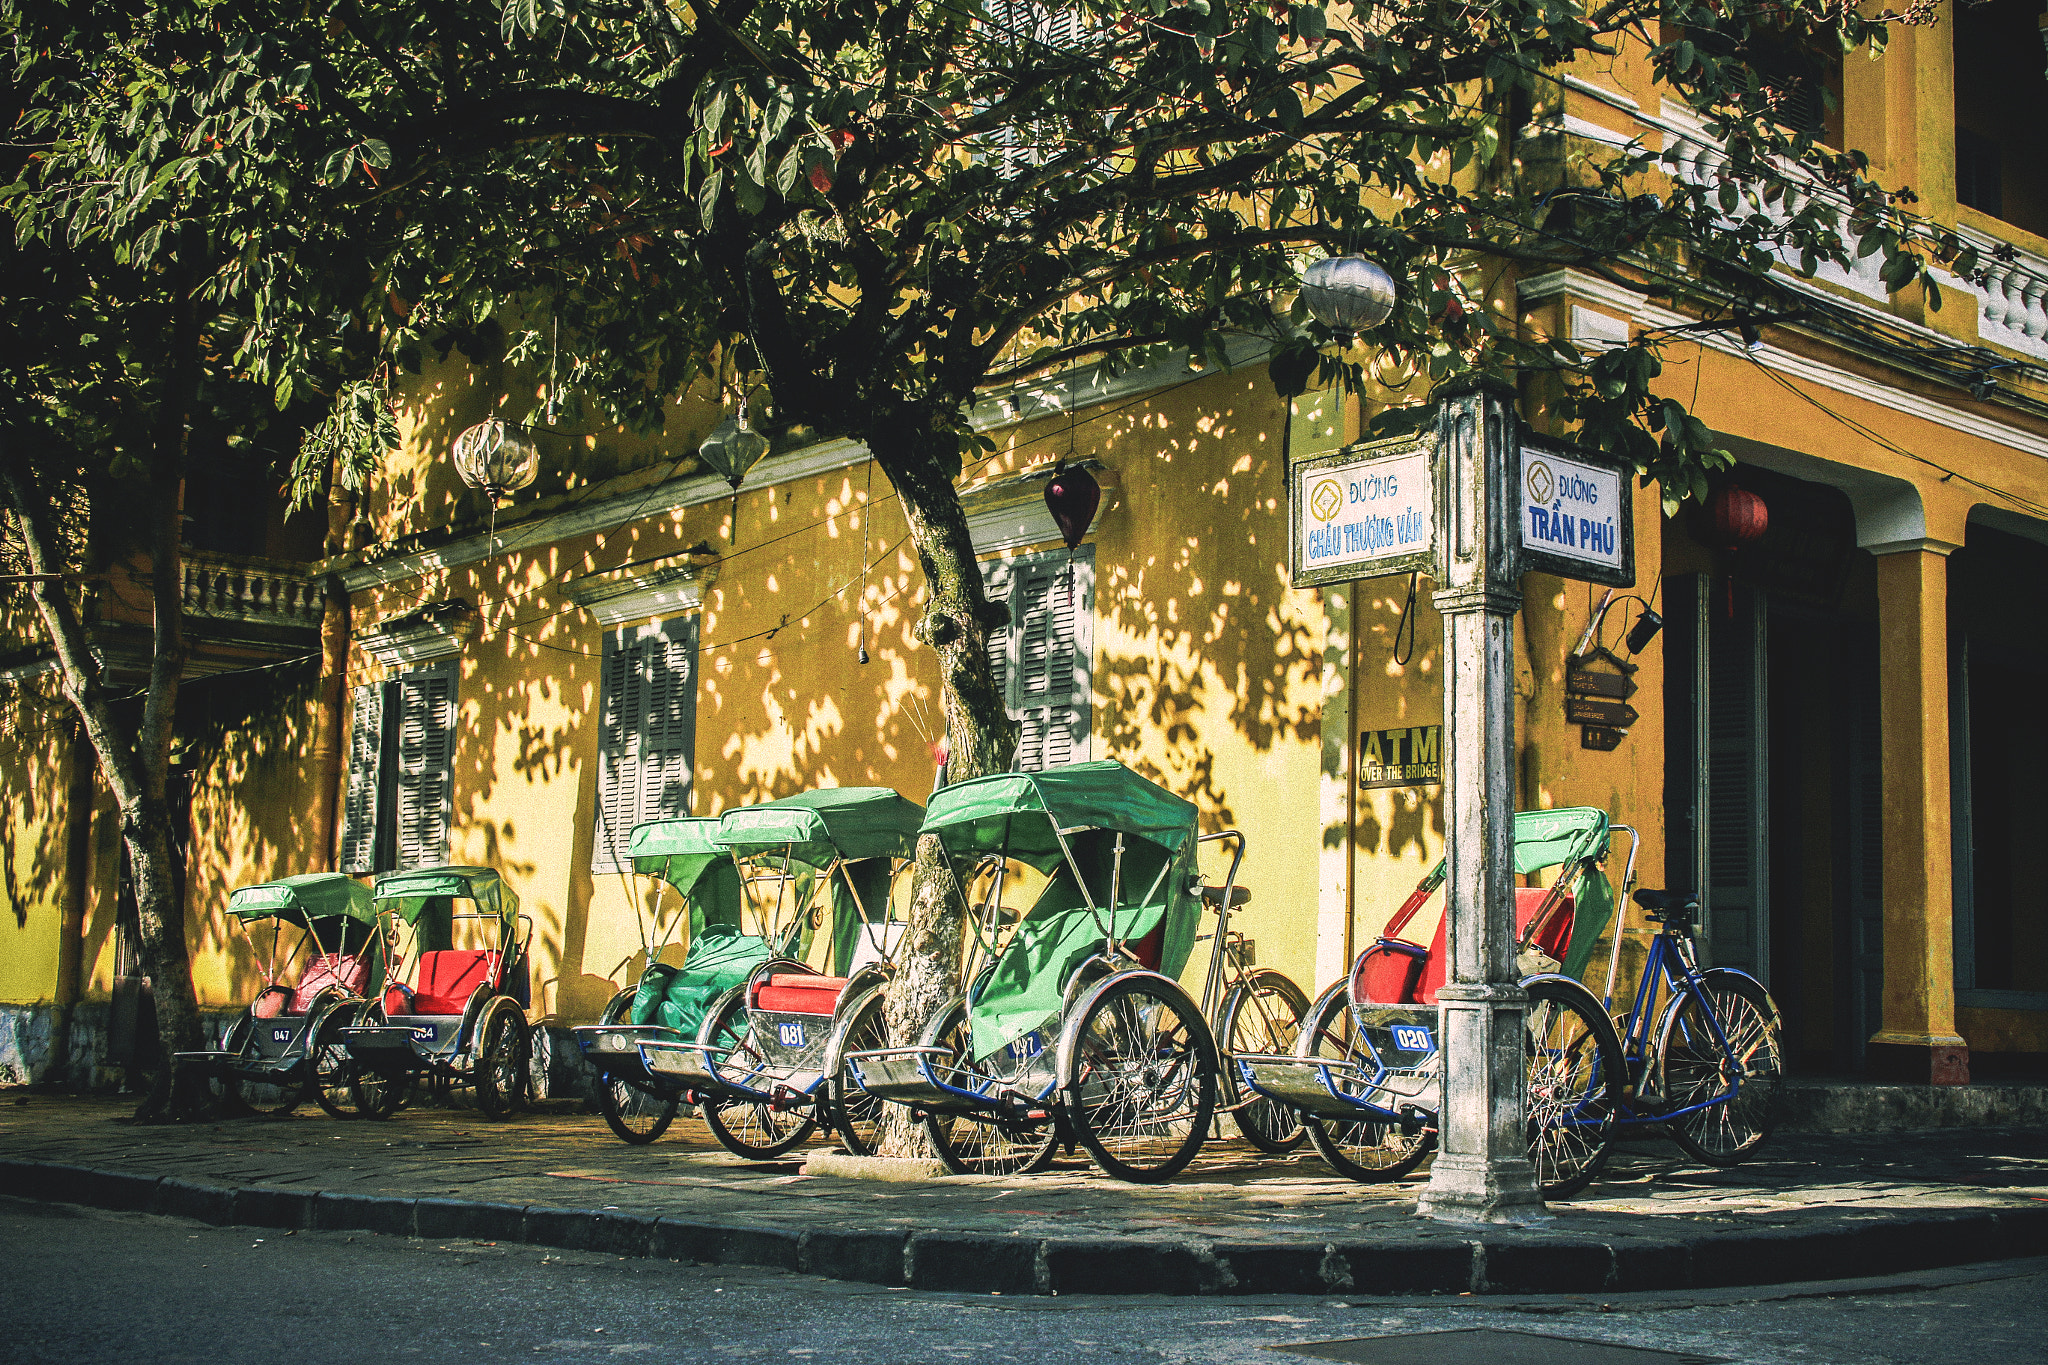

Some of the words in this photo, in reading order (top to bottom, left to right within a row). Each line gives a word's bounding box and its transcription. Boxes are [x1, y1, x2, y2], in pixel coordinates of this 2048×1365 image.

[1349, 473, 1398, 504] ĐƯỜNG
[1308, 521, 1342, 560] CHÂU
[1343, 513, 1394, 555] THƯỢNG
[1396, 505, 1423, 545] VĂN
[1528, 498, 1575, 548] TRẦN
[1580, 516, 1615, 556] PHÚ
[1361, 725, 1438, 767] ATM
[1360, 765, 1383, 782] OVER
[1386, 764, 1403, 780] THE
[1405, 762, 1438, 779] BRIDGE
[274, 1030, 290, 1041] 047
[780, 1025, 804, 1046] 081
[1397, 1029, 1429, 1049] 020
